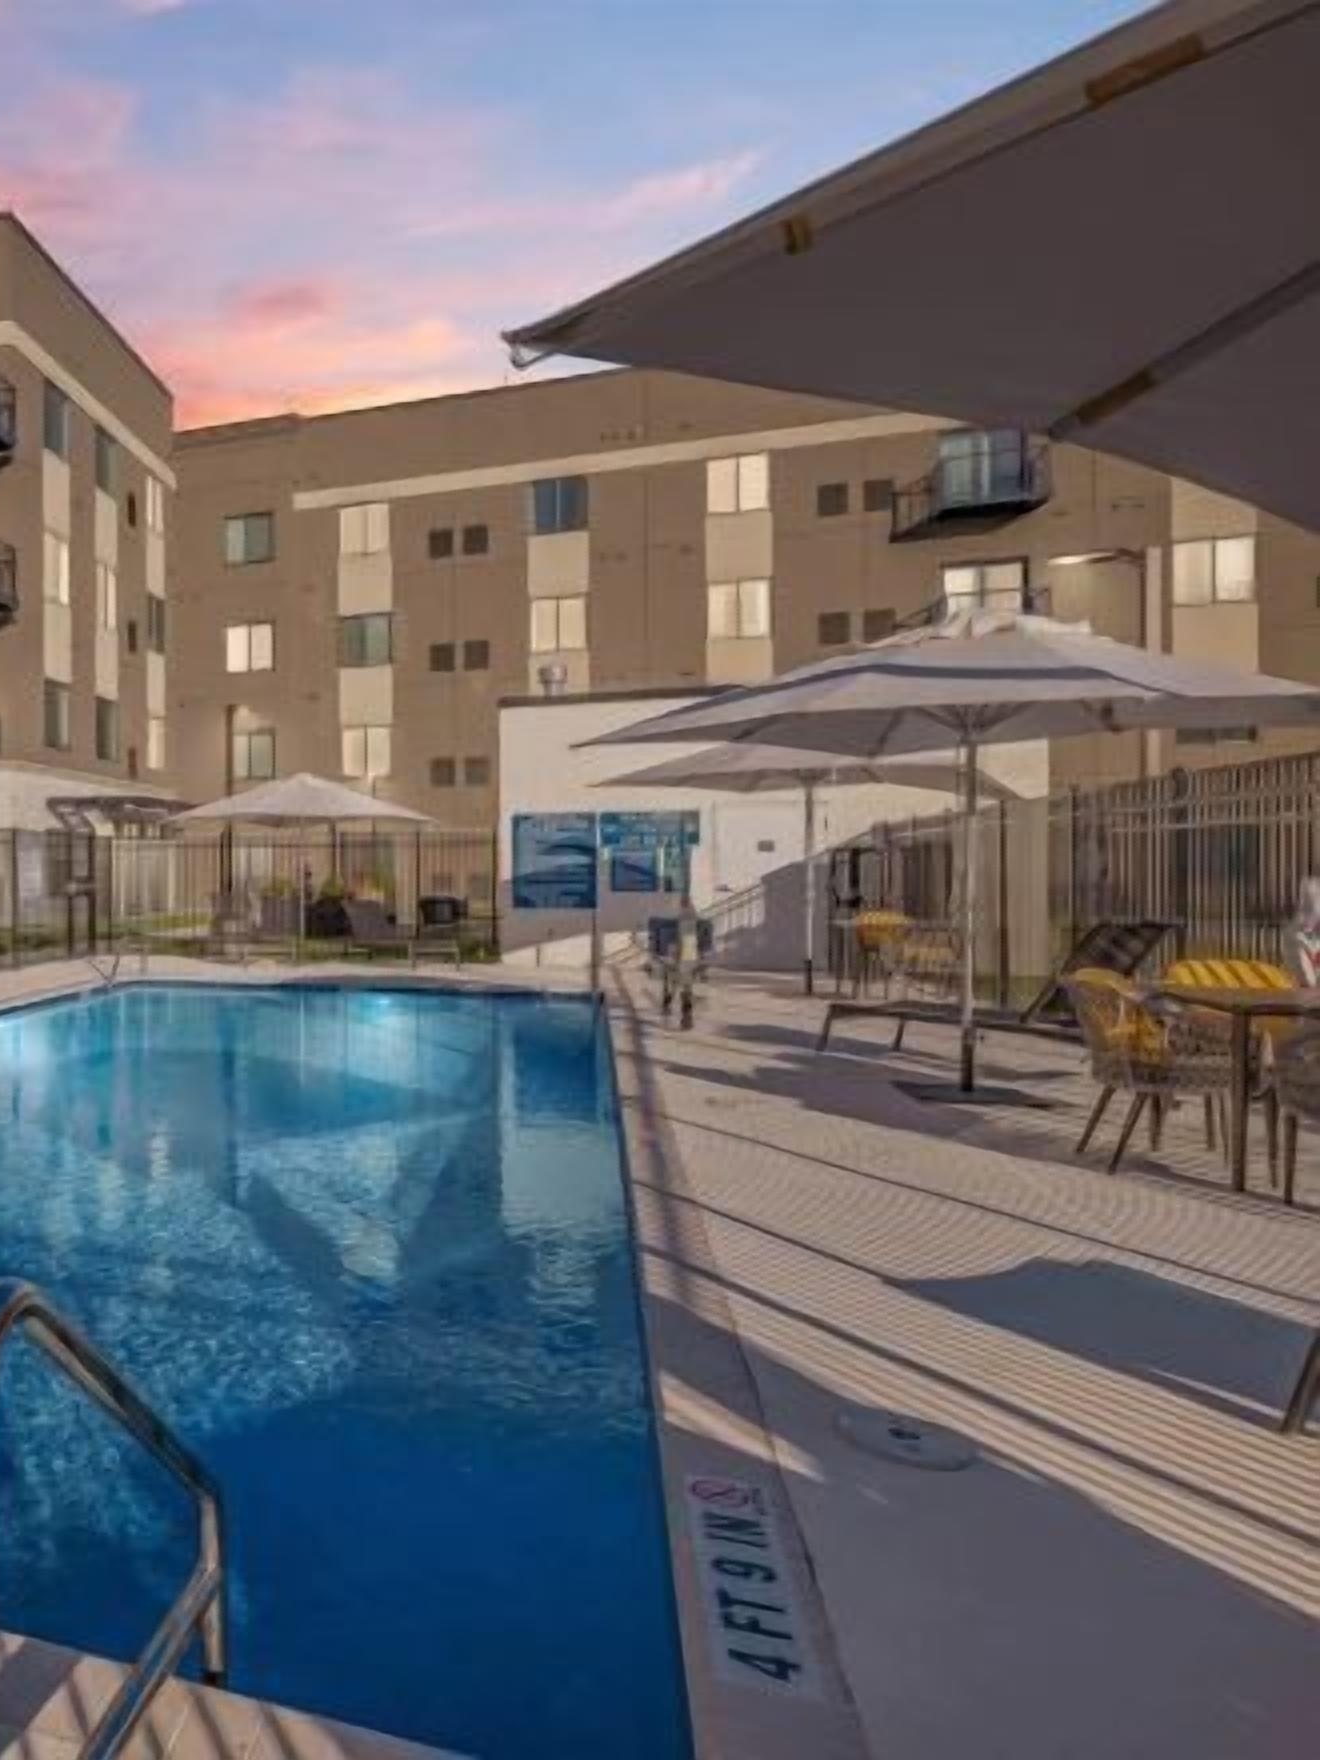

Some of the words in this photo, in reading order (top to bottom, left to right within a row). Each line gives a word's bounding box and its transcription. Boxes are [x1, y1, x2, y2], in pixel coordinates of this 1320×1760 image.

[711, 1556, 777, 1582] 9
[716, 1587, 794, 1641] FT
[727, 1647, 802, 1683] 4
